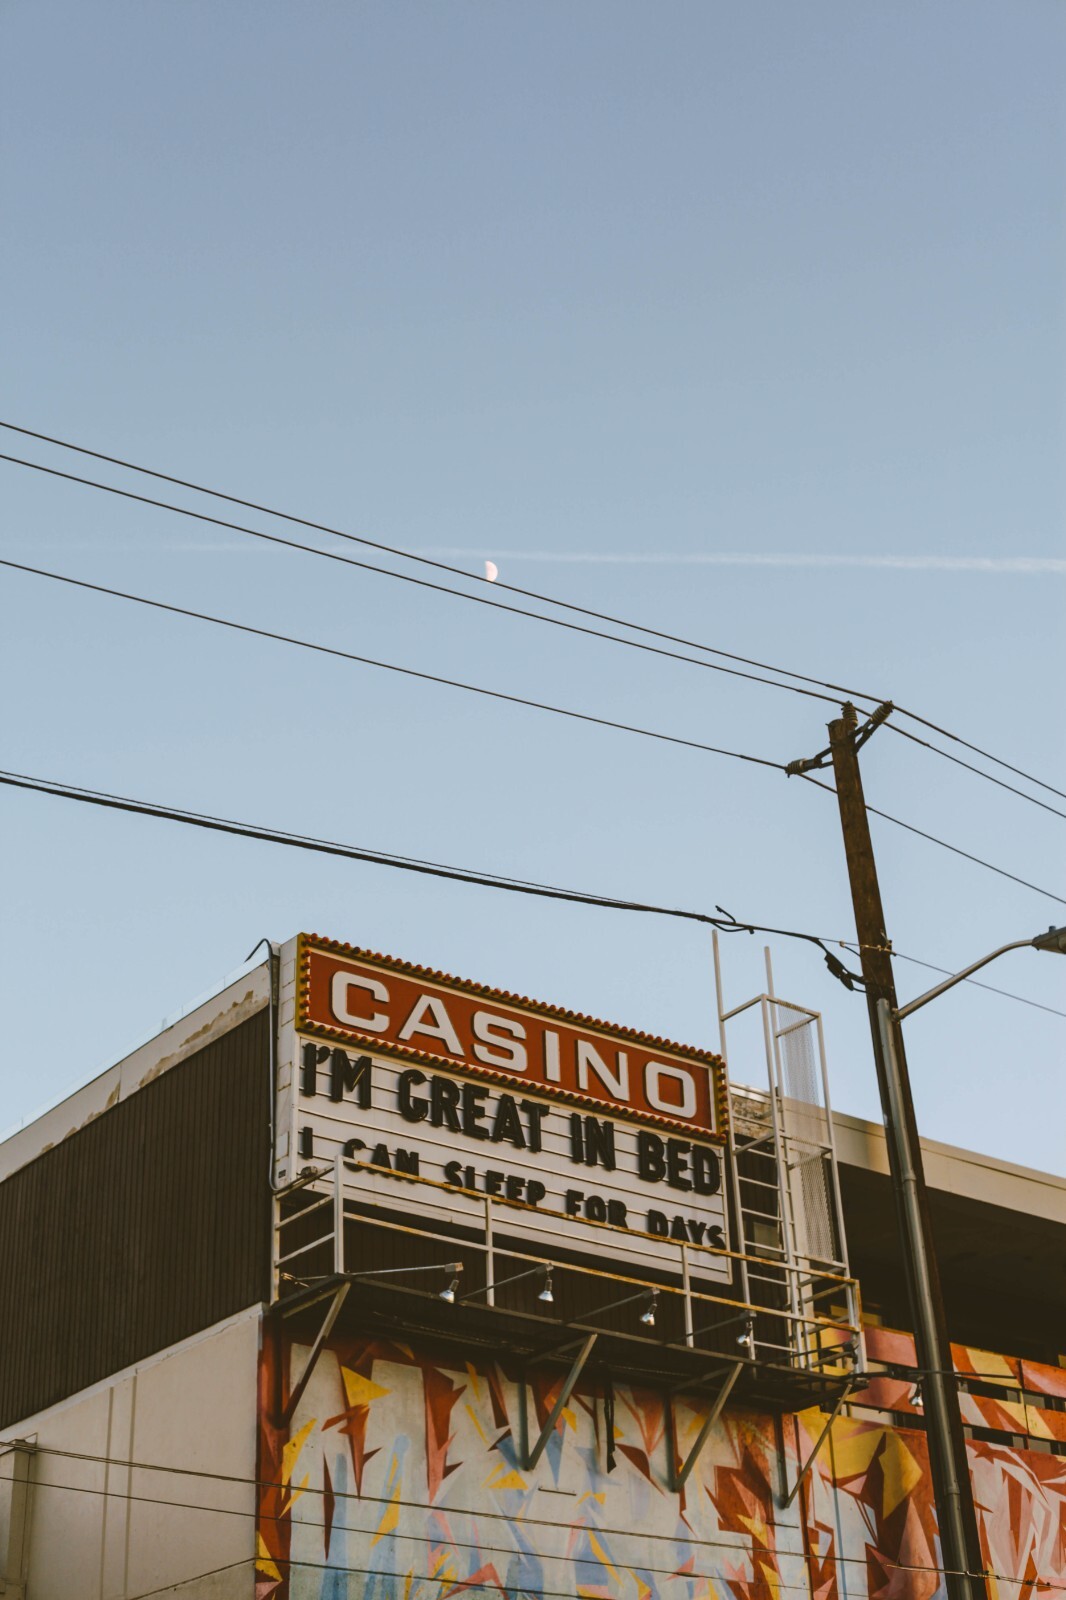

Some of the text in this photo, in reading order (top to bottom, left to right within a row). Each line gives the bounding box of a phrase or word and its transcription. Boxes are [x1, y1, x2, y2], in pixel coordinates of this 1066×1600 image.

[303, 1042, 720, 1195] I'M GREAT IN BED
[332, 971, 697, 1119] CASINO
[302, 1126, 726, 1256] I CAN SLEEP FOR DAYS
